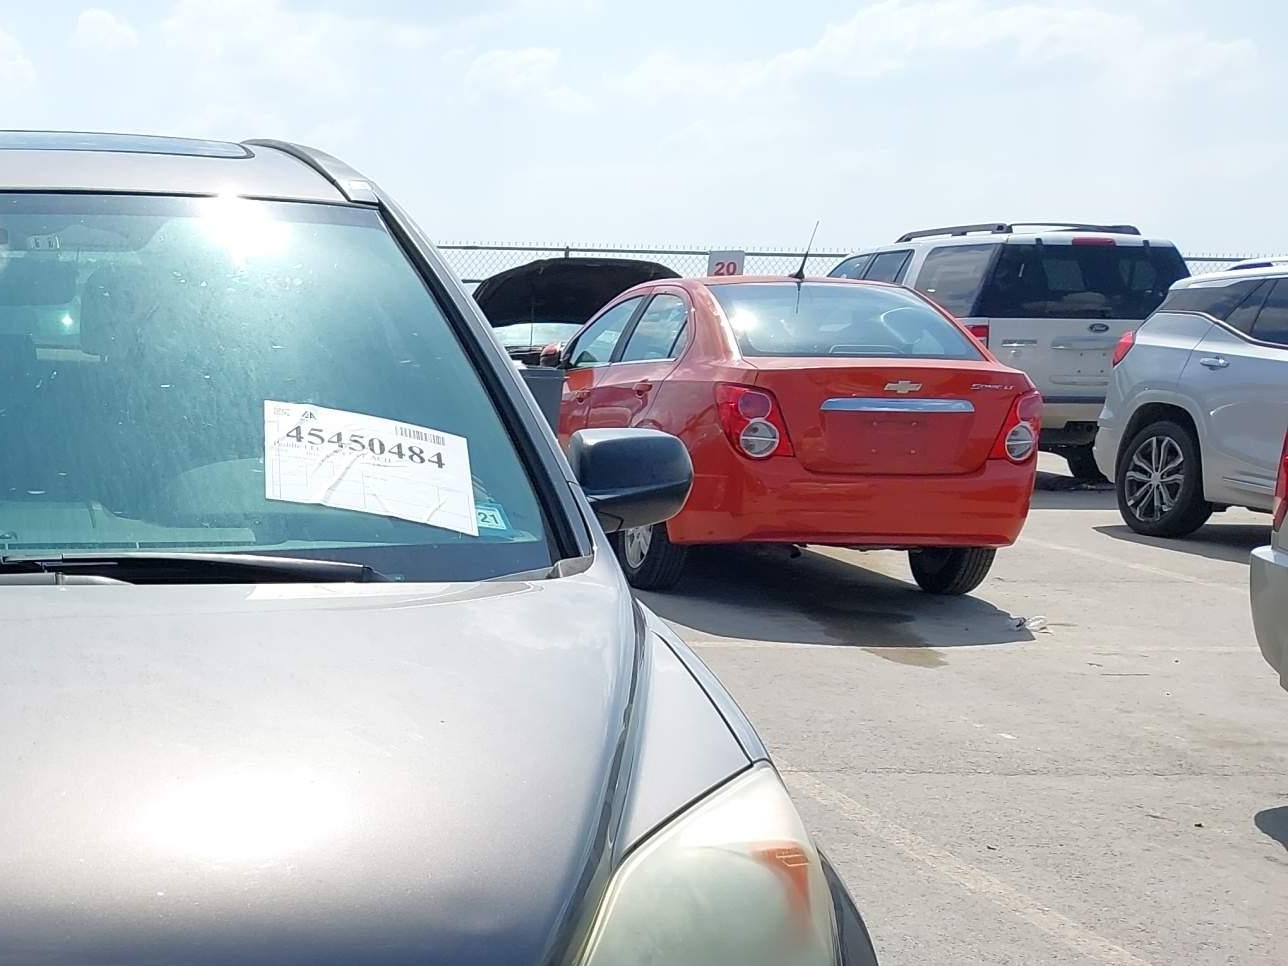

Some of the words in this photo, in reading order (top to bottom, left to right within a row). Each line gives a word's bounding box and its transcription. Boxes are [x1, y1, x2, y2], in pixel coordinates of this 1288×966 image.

[713, 261, 738, 277] 20
[285, 425, 446, 469] 45450484
[477, 511, 499, 525] 21
